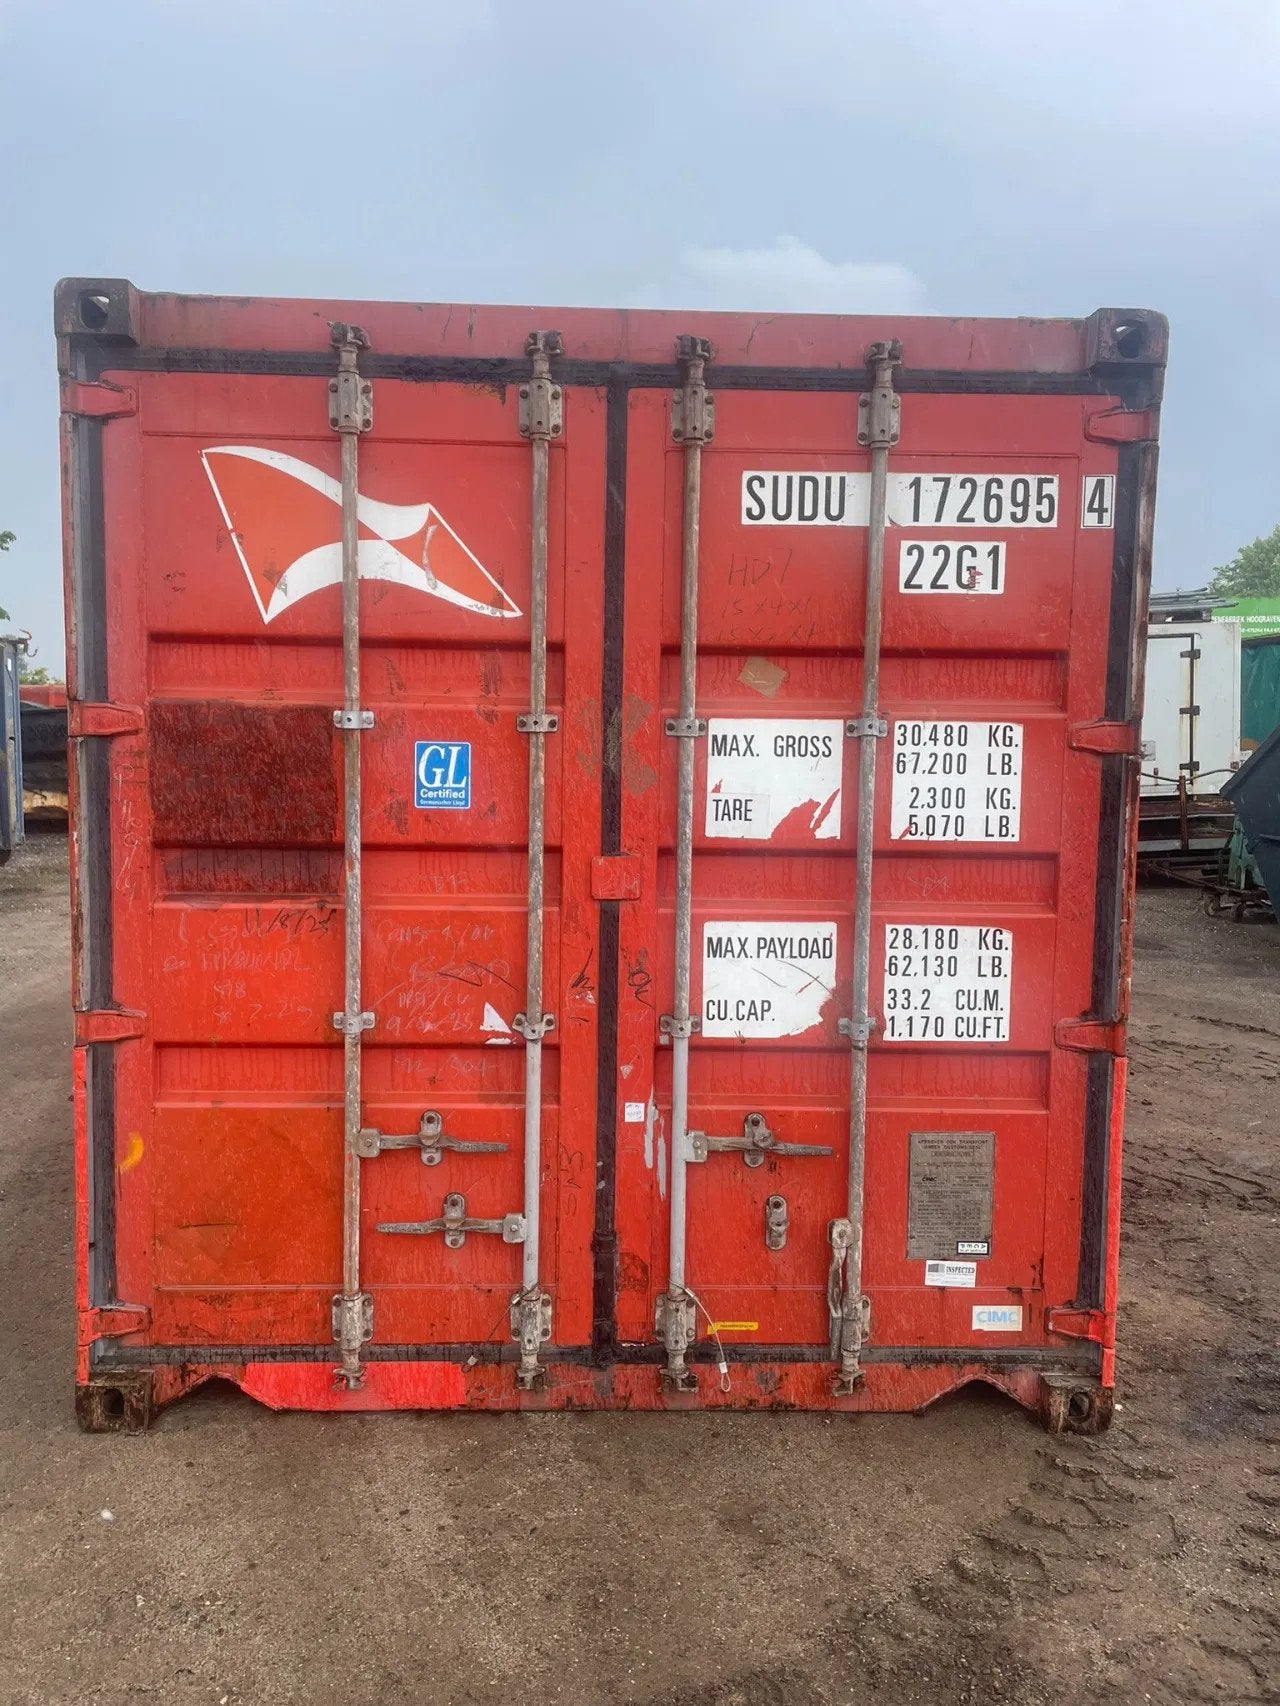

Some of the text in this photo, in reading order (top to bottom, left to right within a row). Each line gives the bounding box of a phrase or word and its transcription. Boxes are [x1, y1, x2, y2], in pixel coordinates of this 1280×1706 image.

[745, 475, 1109, 525] SUDU 172695 4
[903, 544, 1000, 591] 22G1
[711, 734, 832, 758] MAX. GROSS
[988, 724, 1019, 748] KG.
[418, 744, 467, 788] GL
[987, 752, 1018, 776] LB.
[420, 788, 466, 799] Certified
[986, 787, 1016, 810] KG.
[712, 798, 753, 822] TARE
[984, 815, 1015, 838] LB.
[978, 928, 1009, 951] KG.
[977, 955, 1008, 978] LB.
[887, 988, 931, 1010] 33.2
[945, 1265, 976, 1274] INSPECTED
[976, 1309, 1018, 1324] CIMC
